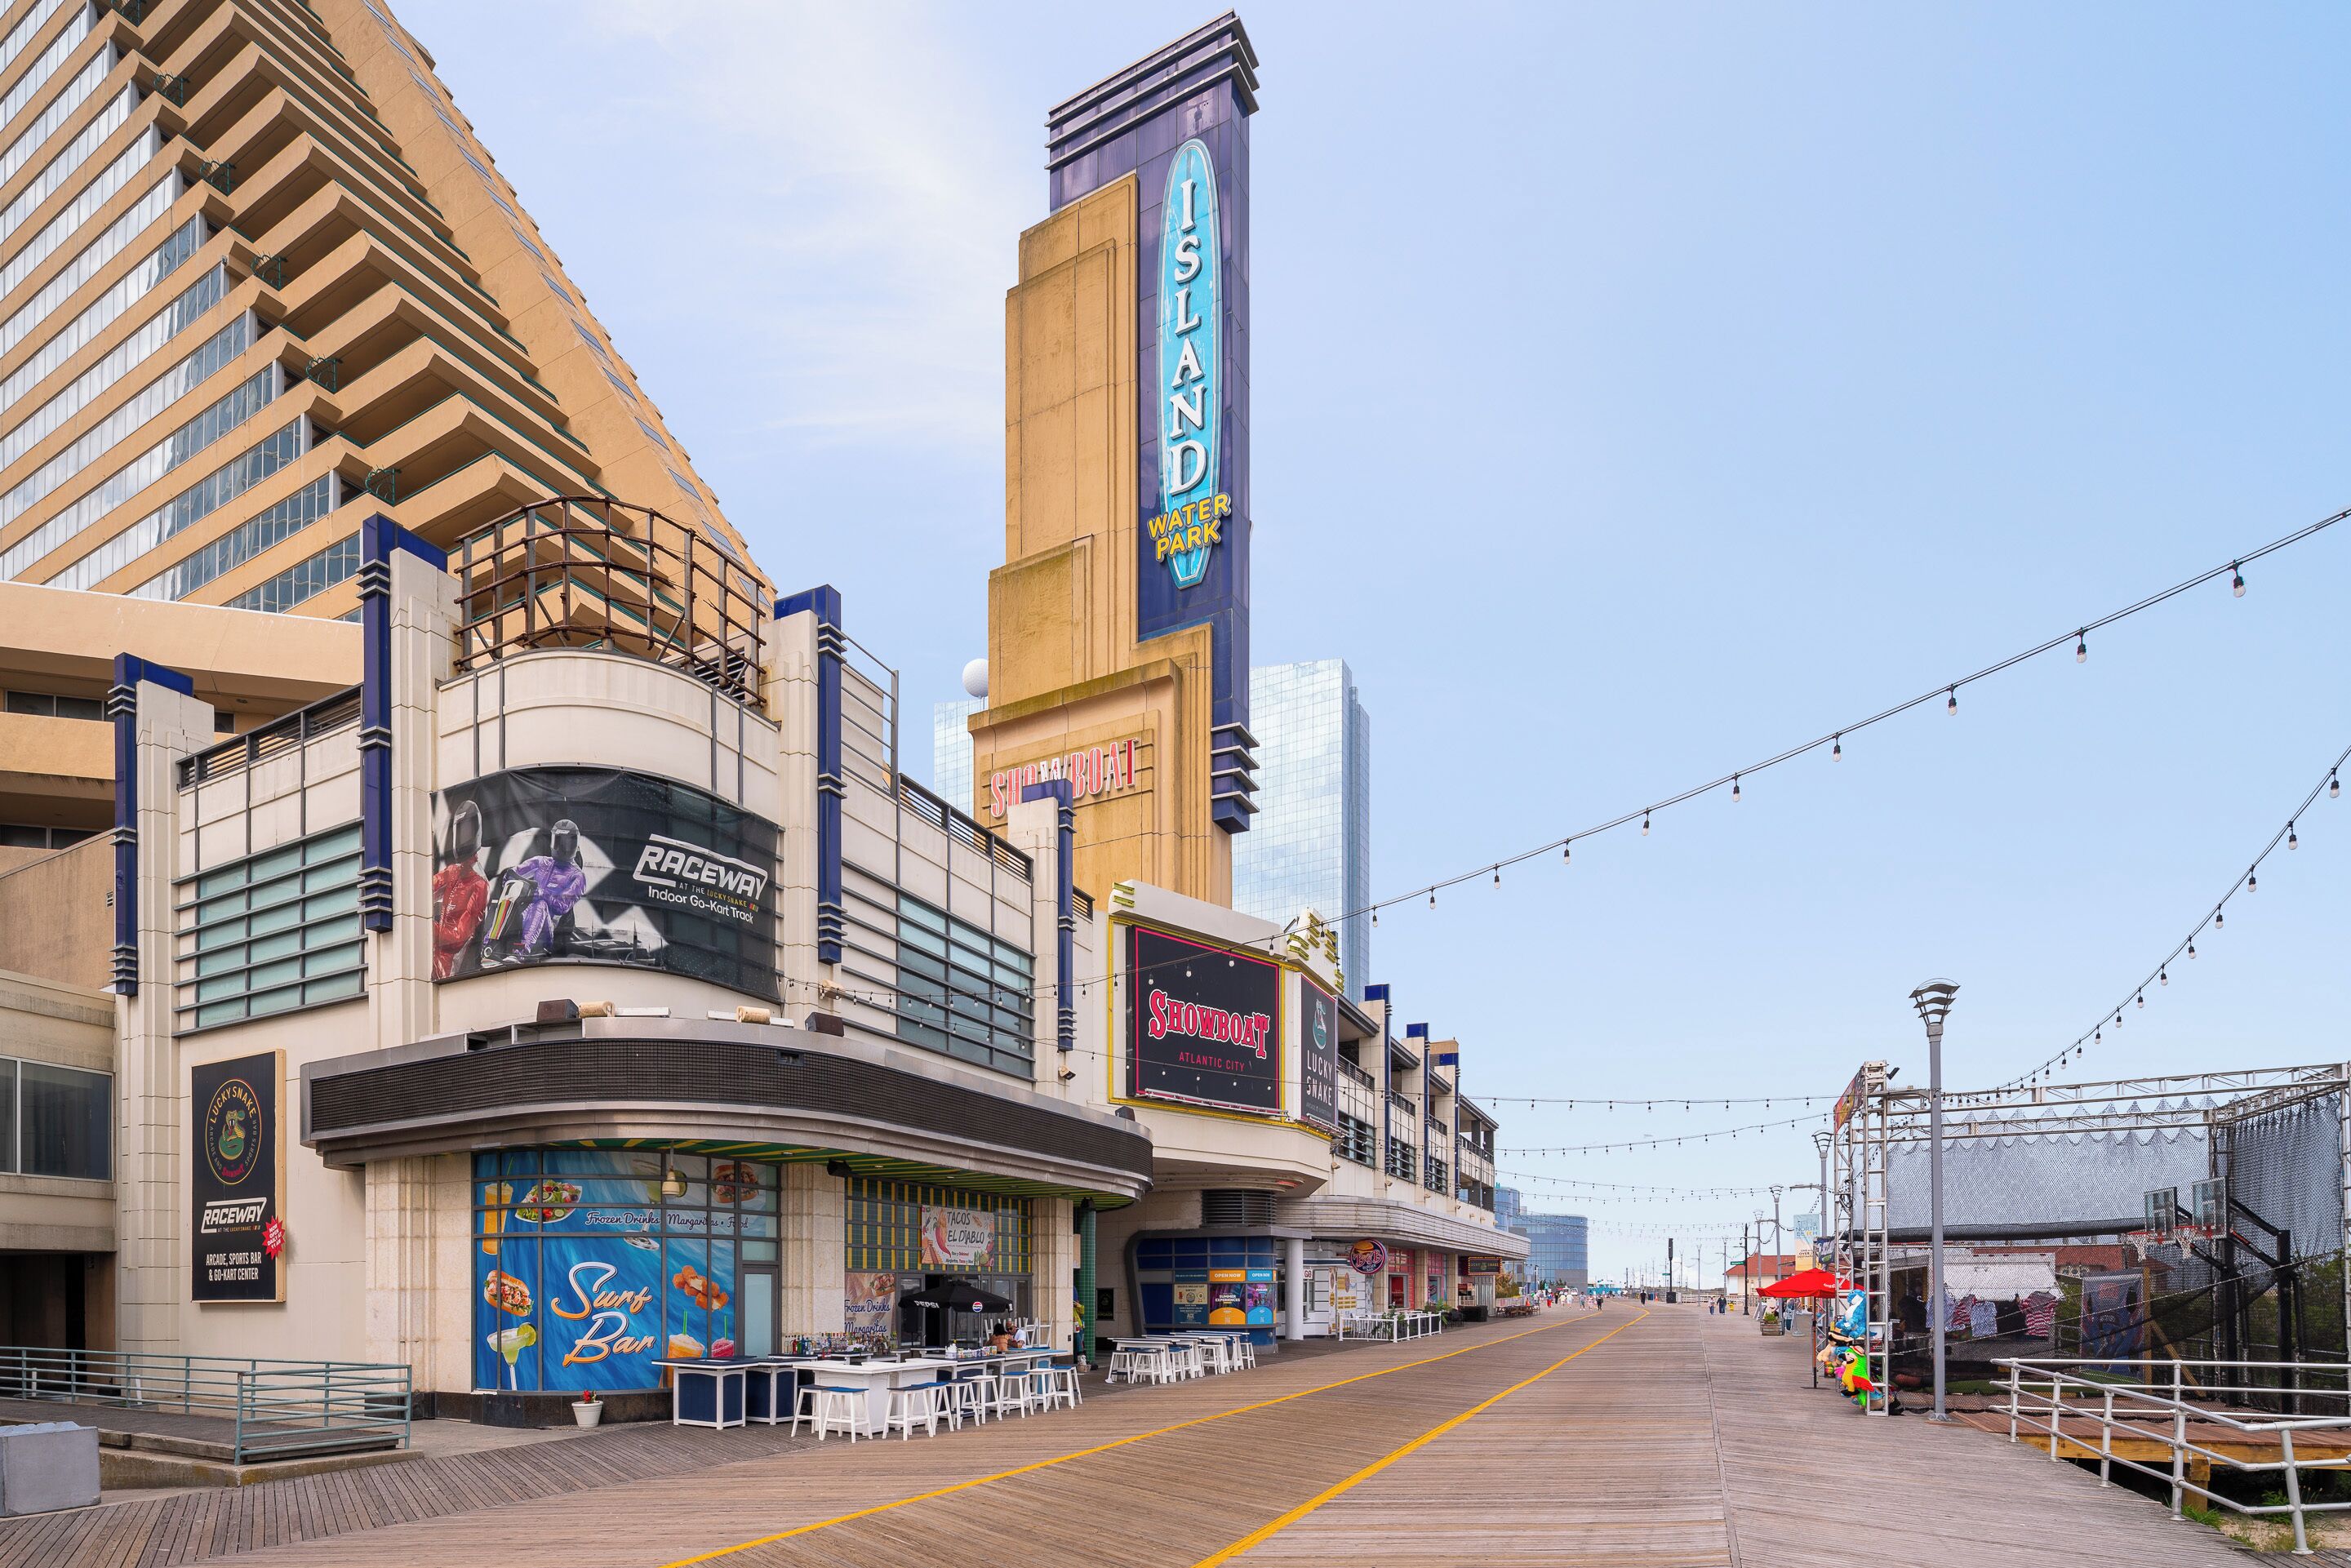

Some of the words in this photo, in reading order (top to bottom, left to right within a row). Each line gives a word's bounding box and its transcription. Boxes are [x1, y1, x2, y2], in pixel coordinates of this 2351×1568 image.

[1169, 178, 1208, 496] ISLAND
[1147, 492, 1231, 540] WATER
[1155, 518, 1221, 562] PARK
[638, 844, 767, 900] RACEWAY
[678, 882, 688, 891] AT
[691, 885, 705, 895] THE
[648, 886, 687, 904] Indoor
[690, 895, 730, 917] Go-Kart
[731, 906, 753, 925] Track
[1148, 988, 1270, 1059] SHOWBOAT
[1179, 1051, 1223, 1068] ATLANTIC
[1225, 1059, 1245, 1072] CITY
[1307, 1050, 1333, 1082] LUCKY
[1306, 1076, 1332, 1107] SNAKE
[202, 1205, 263, 1225] RACEWAY
[585, 1211, 623, 1225] Frozen
[623, 1211, 660, 1225] Drinks
[727, 1216, 749, 1228] Fod
[947, 1211, 971, 1226] TACOS
[947, 1230, 958, 1242] EL
[206, 1253, 229, 1267] ARCADE,
[229, 1252, 249, 1265] SPORTS
[251, 1251, 261, 1264] BAR
[208, 1268, 213, 1281] &
[214, 1268, 237, 1281] GO-KART
[238, 1268, 259, 1280] CENTER
[550, 1261, 653, 1321] Surf
[844, 1299, 866, 1313] Frozen
[866, 1298, 891, 1313] Drinks
[914, 1300, 940, 1308] PEPSI
[844, 1318, 888, 1335] Margaritas
[562, 1311, 656, 1368] Bar
